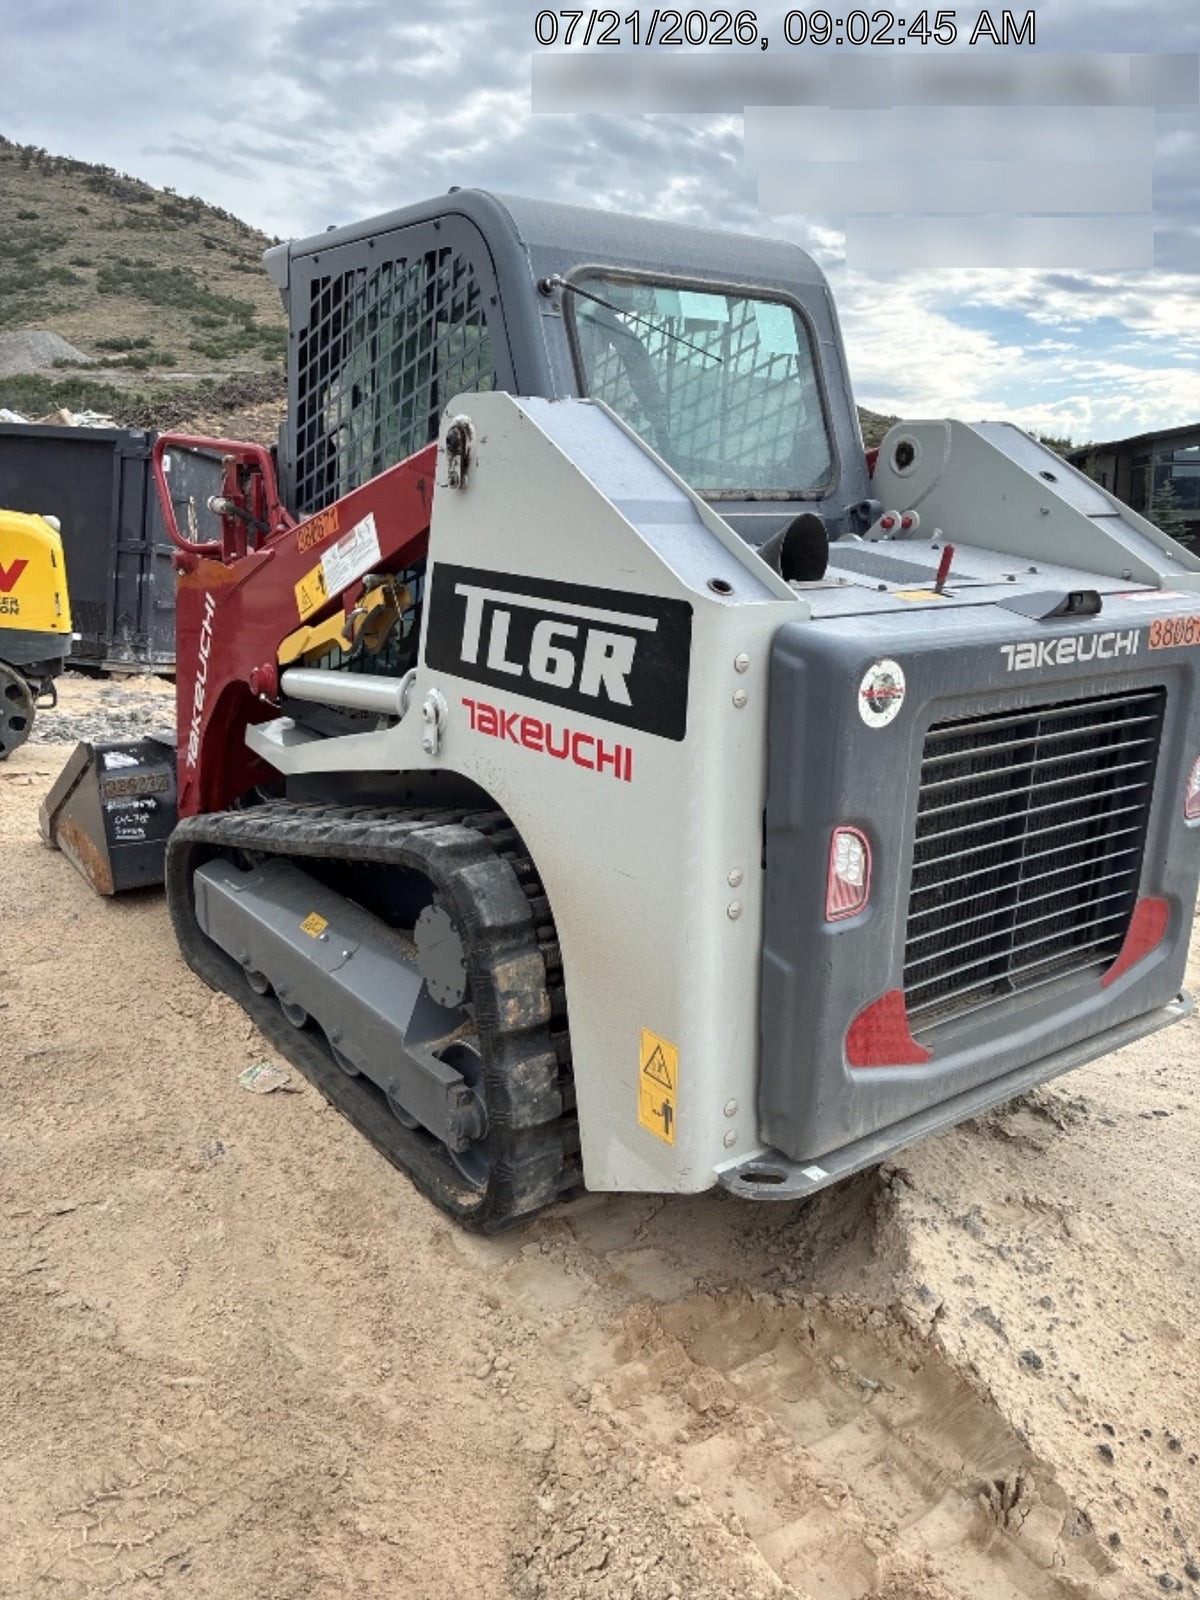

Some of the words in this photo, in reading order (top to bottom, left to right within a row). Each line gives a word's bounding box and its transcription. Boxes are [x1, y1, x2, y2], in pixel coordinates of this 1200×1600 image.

[186, 591, 216, 769] TAKEUCHI
[455, 582, 659, 706] TL6R
[1001, 629, 1140, 671] TAKEUCHI
[461, 697, 632, 783] TAKEUCHI
